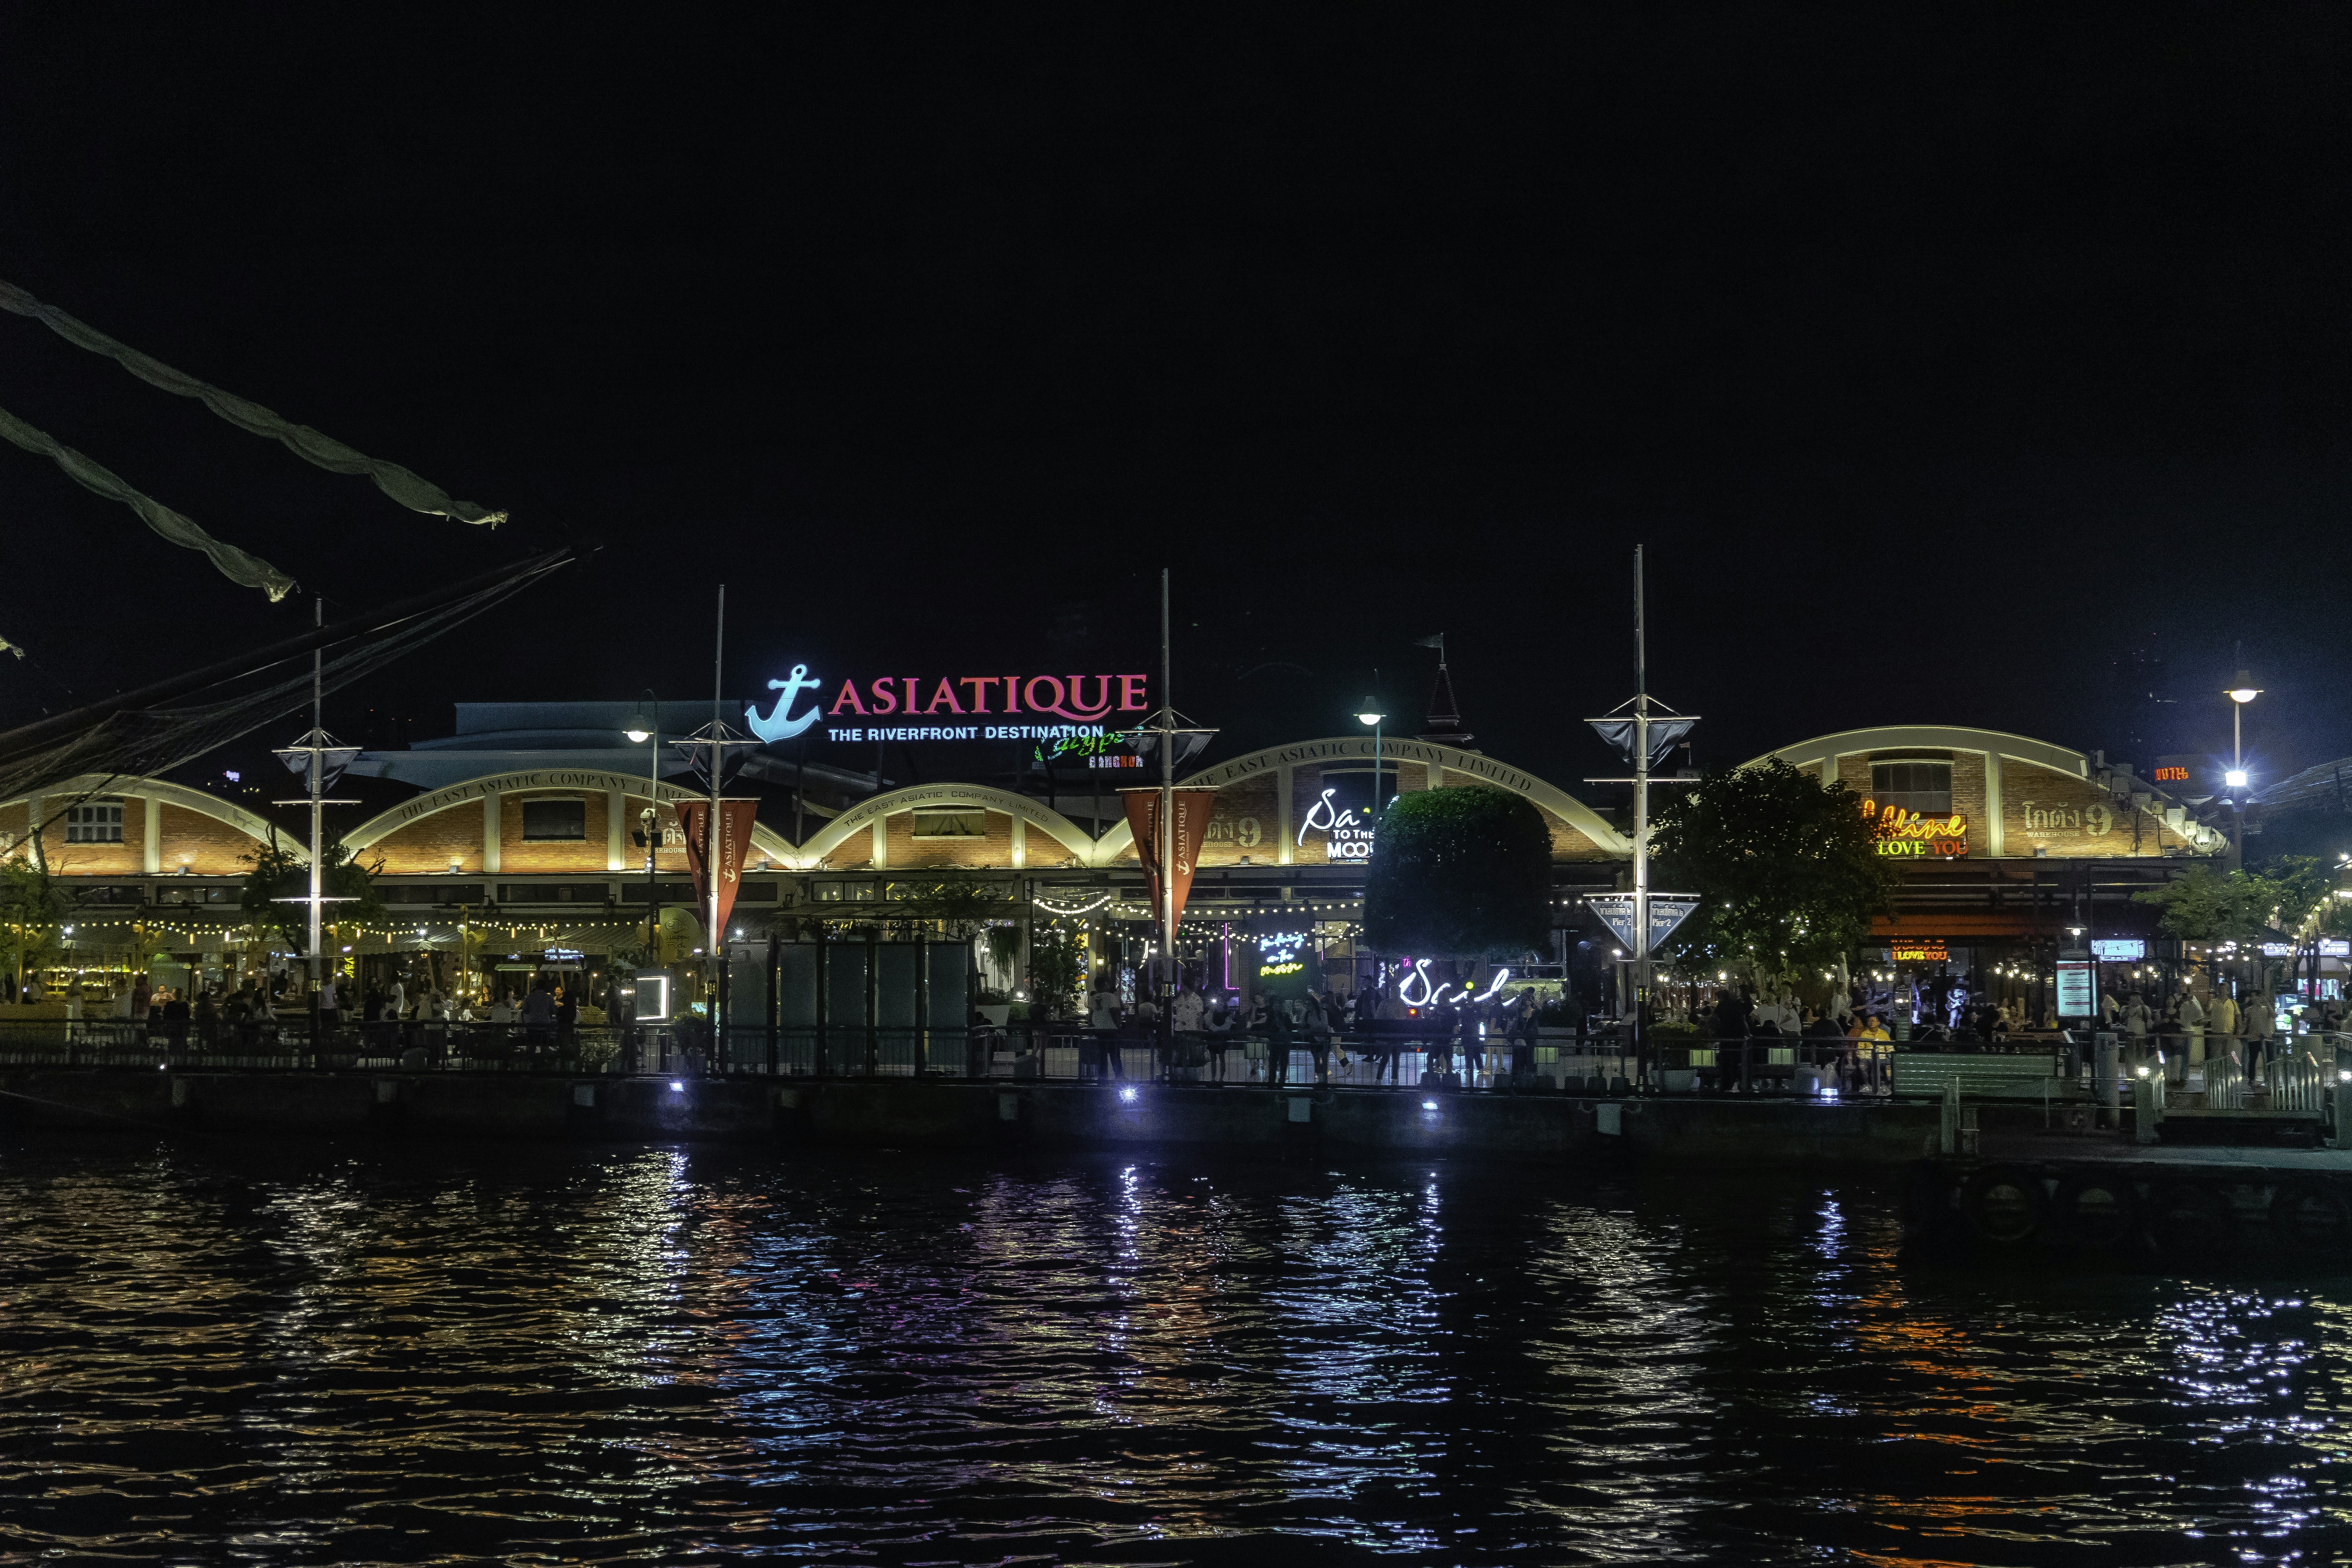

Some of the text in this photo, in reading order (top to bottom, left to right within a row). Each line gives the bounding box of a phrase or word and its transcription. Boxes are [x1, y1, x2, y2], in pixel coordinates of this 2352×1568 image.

[828, 674, 1148, 722] ASIATIQUE
[828, 725, 1104, 741] THE RIVERFRONT DESTINATION
[1034, 725, 1145, 762] alyp
[1225, 754, 1267, 779] EAST
[1278, 742, 1350, 763] ASIATIC
[1360, 742, 1448, 763] COMPANY
[1457, 755, 1531, 791] LIMITED
[400, 801, 428, 820] THE
[432, 786, 472, 808] EAST
[478, 773, 541, 793] ASIATIC
[549, 773, 626, 790] COMPANY
[844, 791, 1048, 827] THE EAST ASIATIC COMPANY LIMITED
[1178, 801, 1187, 859] ASIATIQUE
[1238, 817, 1261, 848] 9
[1332, 829, 1351, 839] TO
[2085, 804, 2113, 837] 9
[725, 811, 733, 867] ASIATIQUE
[1877, 840, 1968, 855] LOVE YOU
[1612, 918, 1625, 926] Pier
[1652, 918, 1671, 927] Pier 2
[1897, 951, 1925, 960] LOVE
[1924, 951, 1947, 960] YOU
